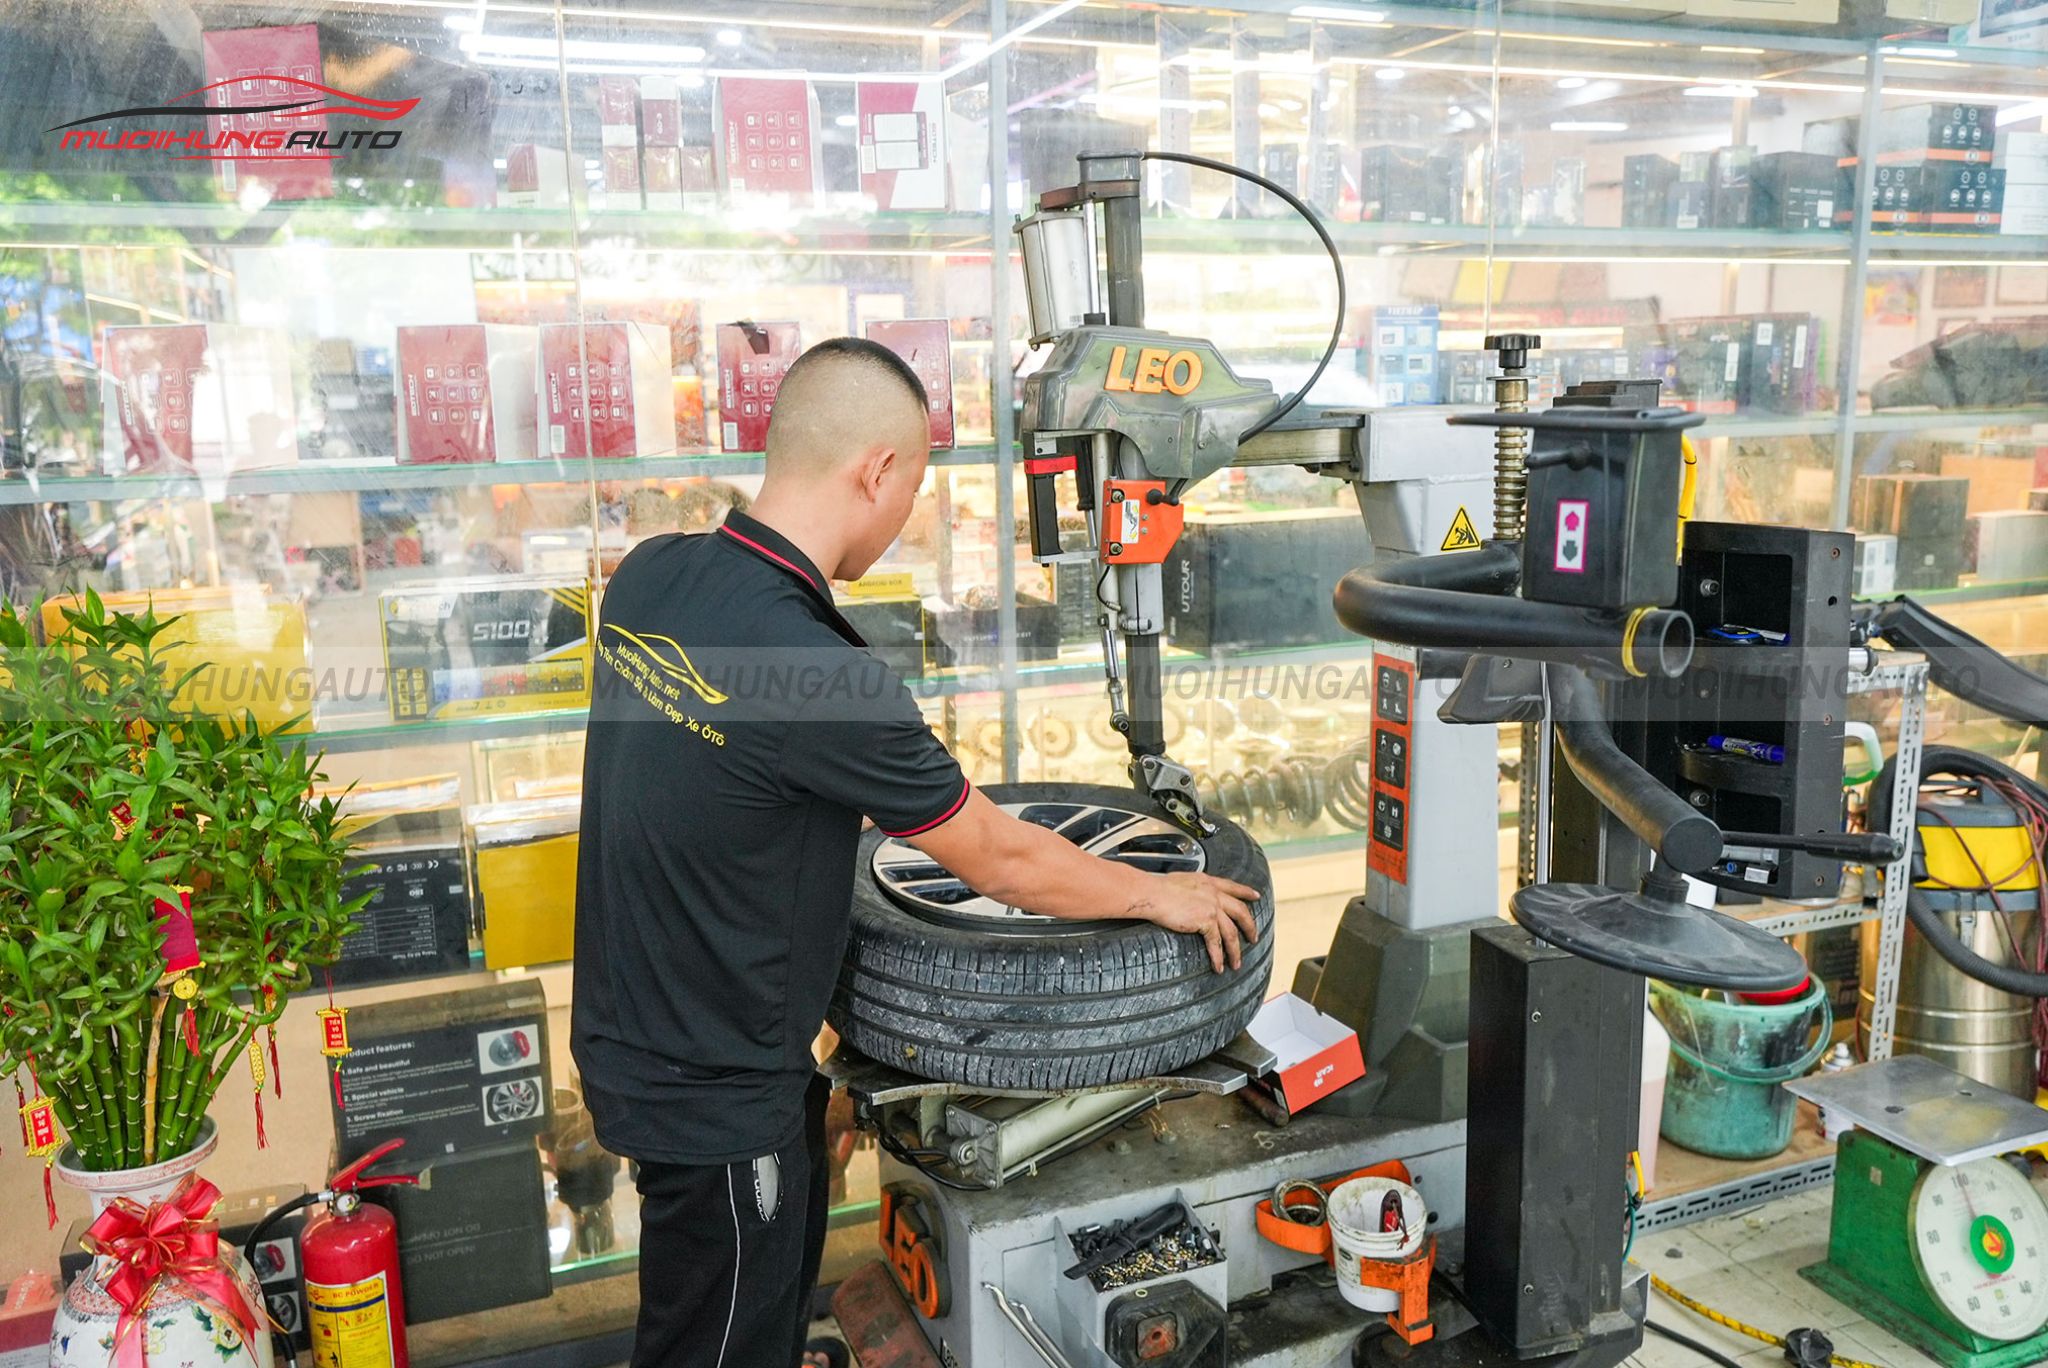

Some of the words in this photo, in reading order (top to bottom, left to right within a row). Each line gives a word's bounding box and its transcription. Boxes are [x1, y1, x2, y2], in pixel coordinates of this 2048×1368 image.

[1104, 345, 1203, 396] LEO
[1182, 560, 1190, 613] UTOUR
[472, 620, 530, 641] S100
[685, 715, 700, 733] Xe
[376, 1041, 415, 1054] features:
[365, 1063, 378, 1073] and
[379, 1059, 411, 1070] beautiful
[351, 1089, 378, 1101] Special
[379, 1086, 405, 1097] vehicle
[354, 1113, 376, 1122] Screw
[377, 1109, 404, 1119] fixation
[1952, 1174, 1969, 1189] 100
[2010, 1207, 2024, 1221] 20
[1927, 1230, 1941, 1245] 80
[332, 1291, 343, 1299] BC
[345, 1282, 379, 1297] POWDER
[2019, 1281, 2032, 1295] 40
[1967, 1296, 1981, 1312] 60
